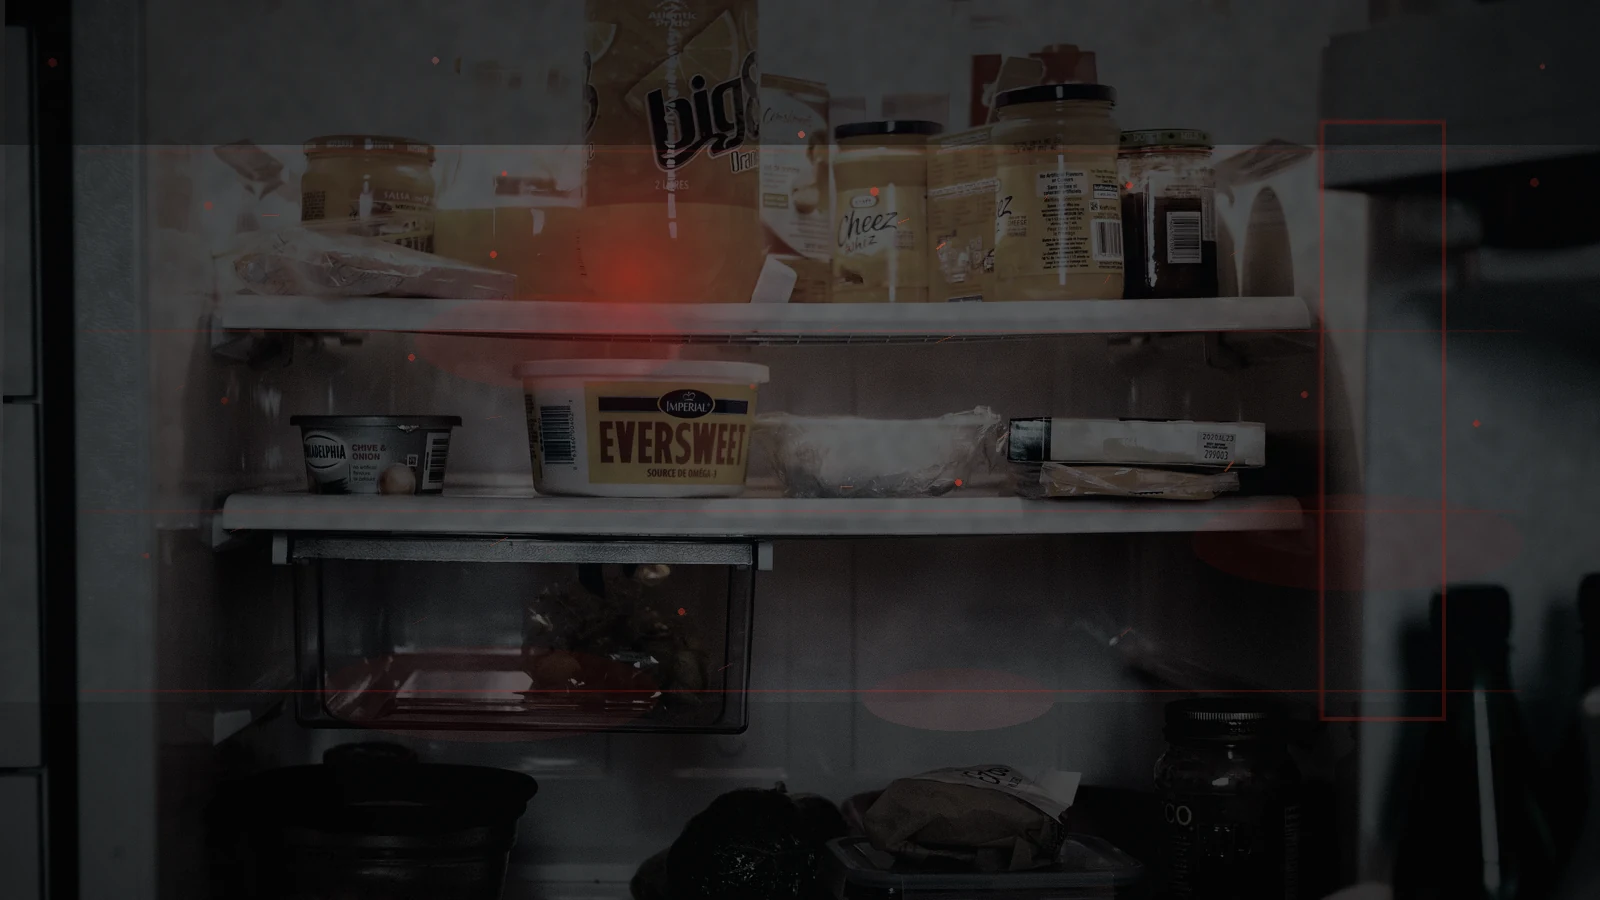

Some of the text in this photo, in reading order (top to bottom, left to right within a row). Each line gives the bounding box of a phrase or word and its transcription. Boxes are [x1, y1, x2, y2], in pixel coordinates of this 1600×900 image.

[655, 180, 689, 191] 2 LRES
[383, 190, 410, 201] SALSA
[666, 400, 707, 412] IMPERIAL
[351, 444, 386, 452] CHIVE &
[600, 420, 746, 465] EVERSWEET
[352, 452, 380, 461] ONION
[1204, 449, 1229, 460] 299003
[647, 468, 676, 478] SOURCE
[677, 468, 687, 478] DE
